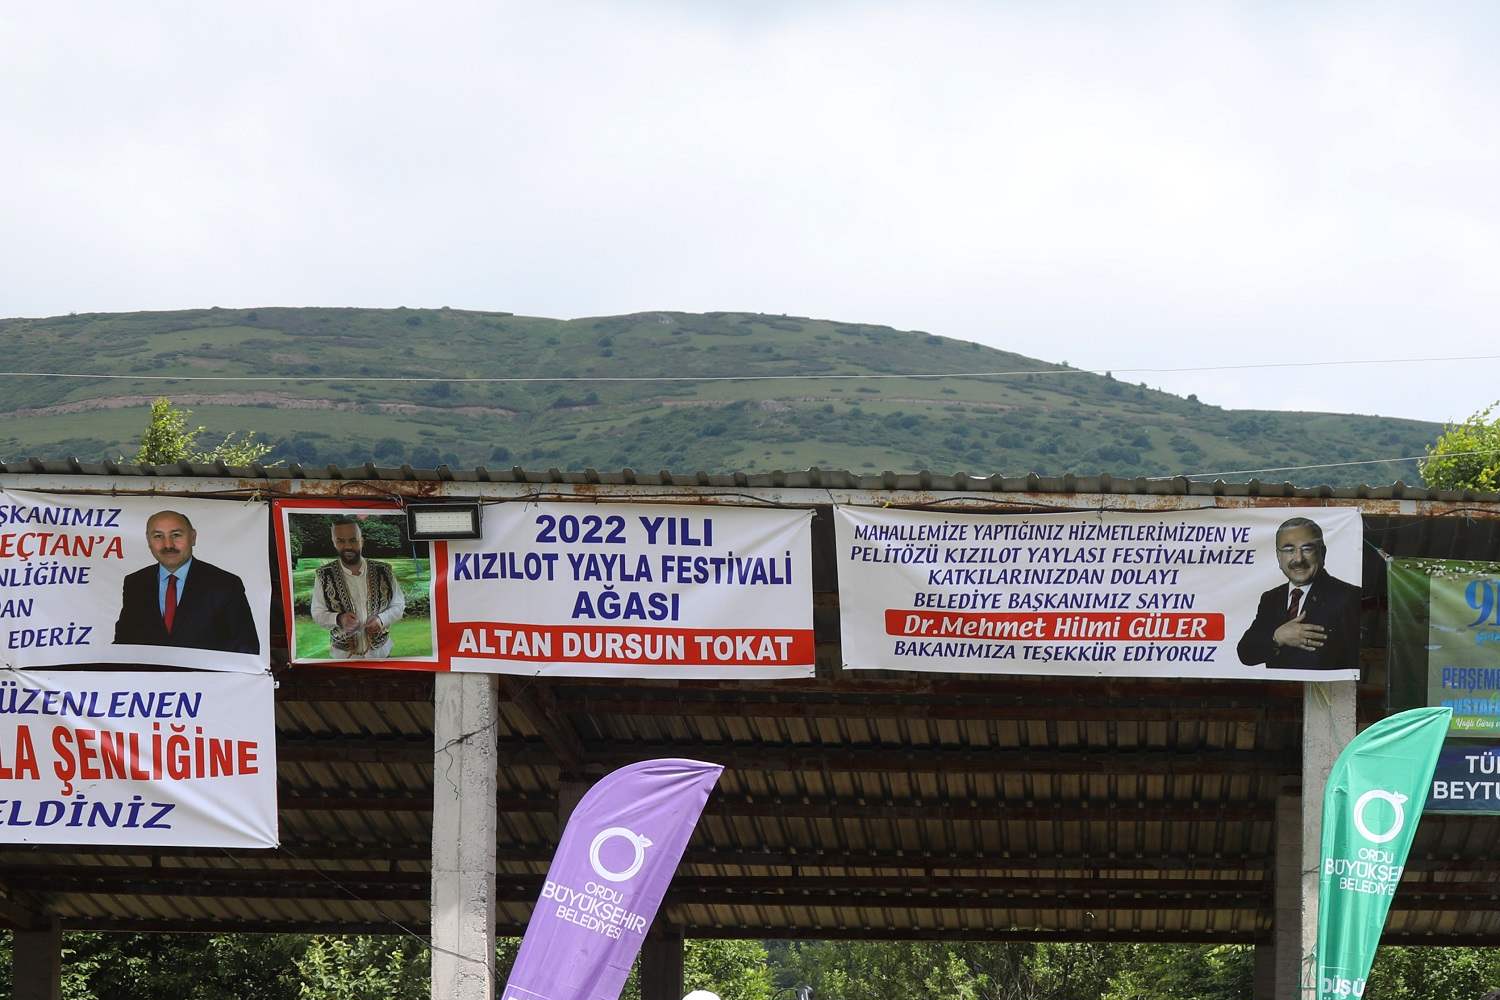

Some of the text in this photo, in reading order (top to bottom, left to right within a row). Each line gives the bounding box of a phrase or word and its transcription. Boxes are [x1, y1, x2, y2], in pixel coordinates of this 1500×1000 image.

[535, 514, 713, 547] 2022 YILI
[854, 521, 1251, 543] MAHALLEMİZE YAPTIĞINIZ HİZMETLERİMİZDEN VE
[850, 543, 1256, 565] PELİTÖZÜ KIZILOT YAYLASI FESTİVALİMİZE
[454, 550, 792, 585] KIZILOT YAYLA FESTİVALİ
[927, 568, 1180, 586] KATKILARINIZDAN DOLAYI
[0, 598, 34, 618] AN
[571, 584, 680, 621] AĞASI
[913, 588, 1196, 612] BELEDİYE BAŞKANIMIZ SAYIN
[8, 622, 93, 649] EDERİZ
[903, 613, 1208, 639] Dr.Mehmet Hilmi GÜLER
[457, 628, 793, 661] ALTAN DURSUN TOKAT
[894, 640, 1218, 663] BAKANIMIZA TEŞEKKÜR EDİYORUZ
[0, 680, 202, 718] ÜZENLENEN
[51, 721, 259, 796] ŞENLİĞİNE
[1358, 847, 1394, 864] ORDU
[585, 881, 624, 904] ORDU
[541, 880, 647, 934] BÜYÜKŞEHİR
[555, 904, 623, 940] BELEDİYESİ
